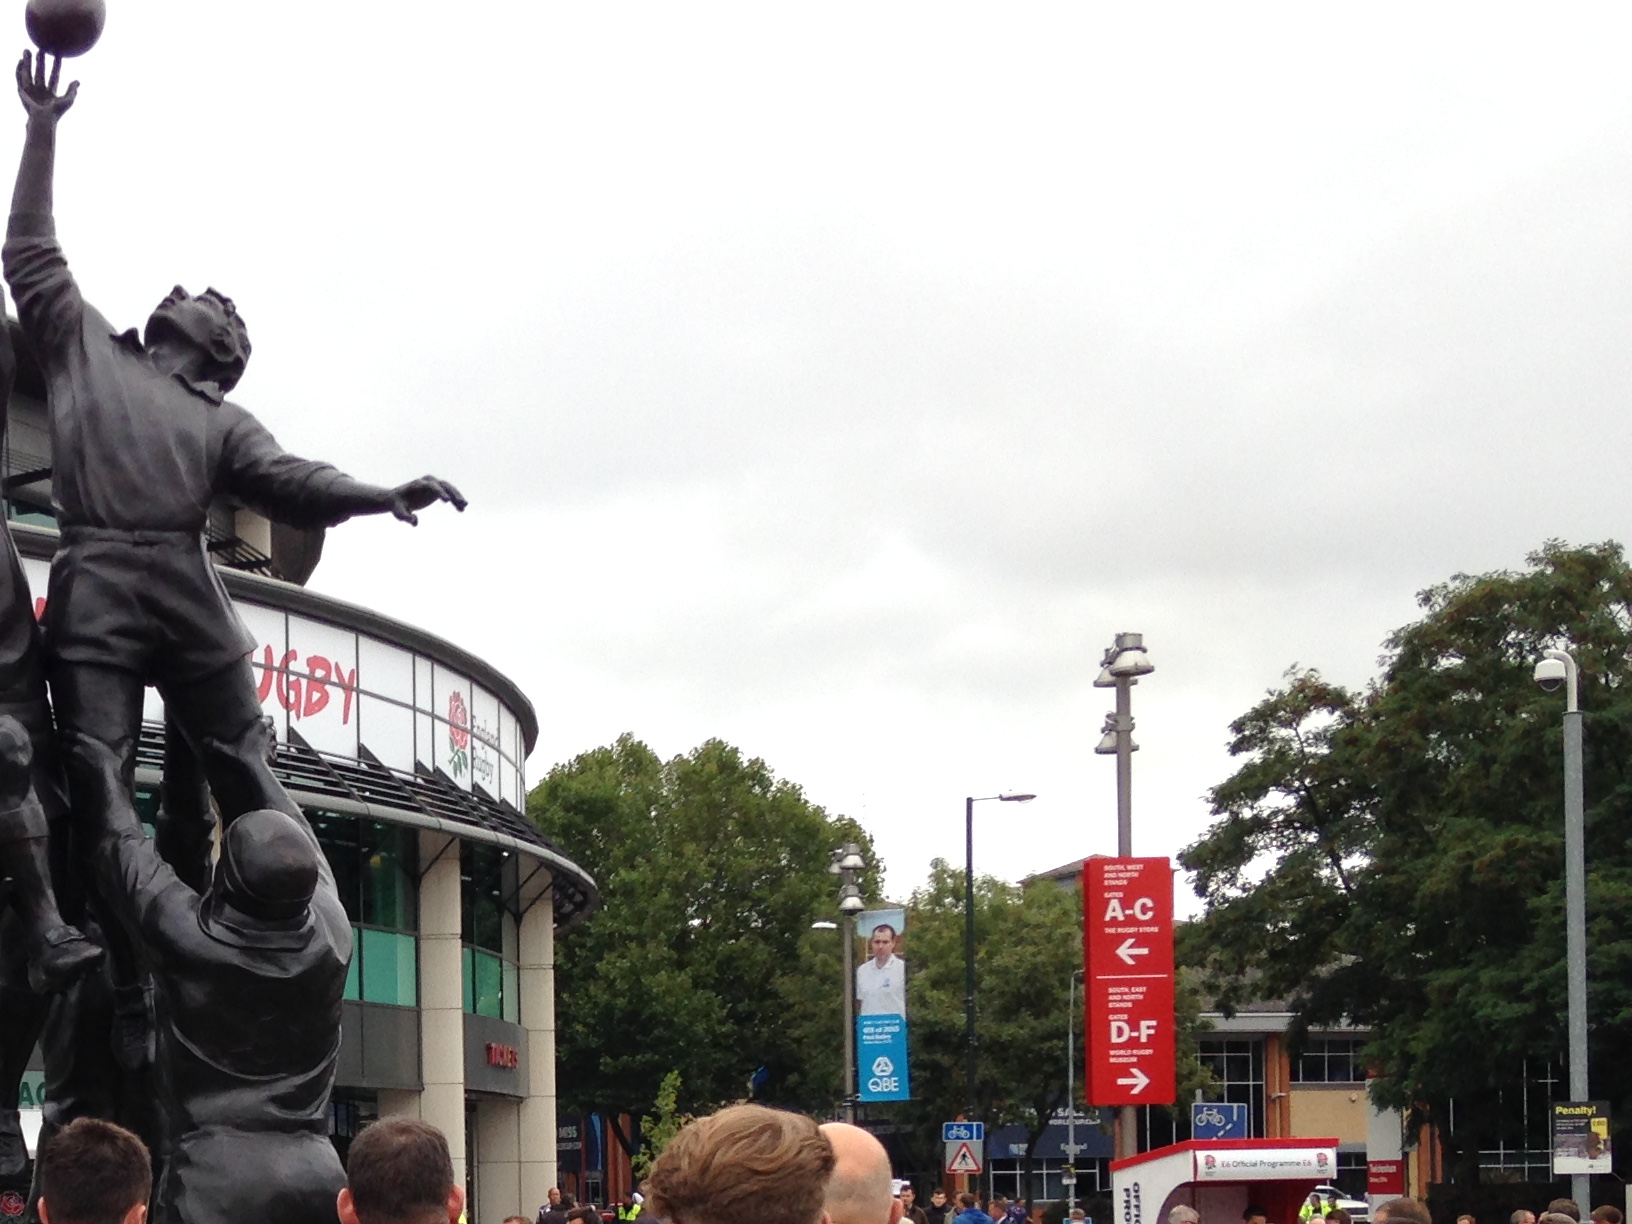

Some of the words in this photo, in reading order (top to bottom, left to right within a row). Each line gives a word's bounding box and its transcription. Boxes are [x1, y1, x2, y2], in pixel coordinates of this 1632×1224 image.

[247, 644, 356, 726] UGBY
[1104, 897, 1154, 921] A-C
[1110, 1020, 1158, 1043] D-F
[868, 1077, 899, 1092] QBE
[1555, 1105, 1597, 1116] Penalty!
[1231, 1160, 1258, 1168] Official
[1259, 1160, 1300, 1169] Programme
